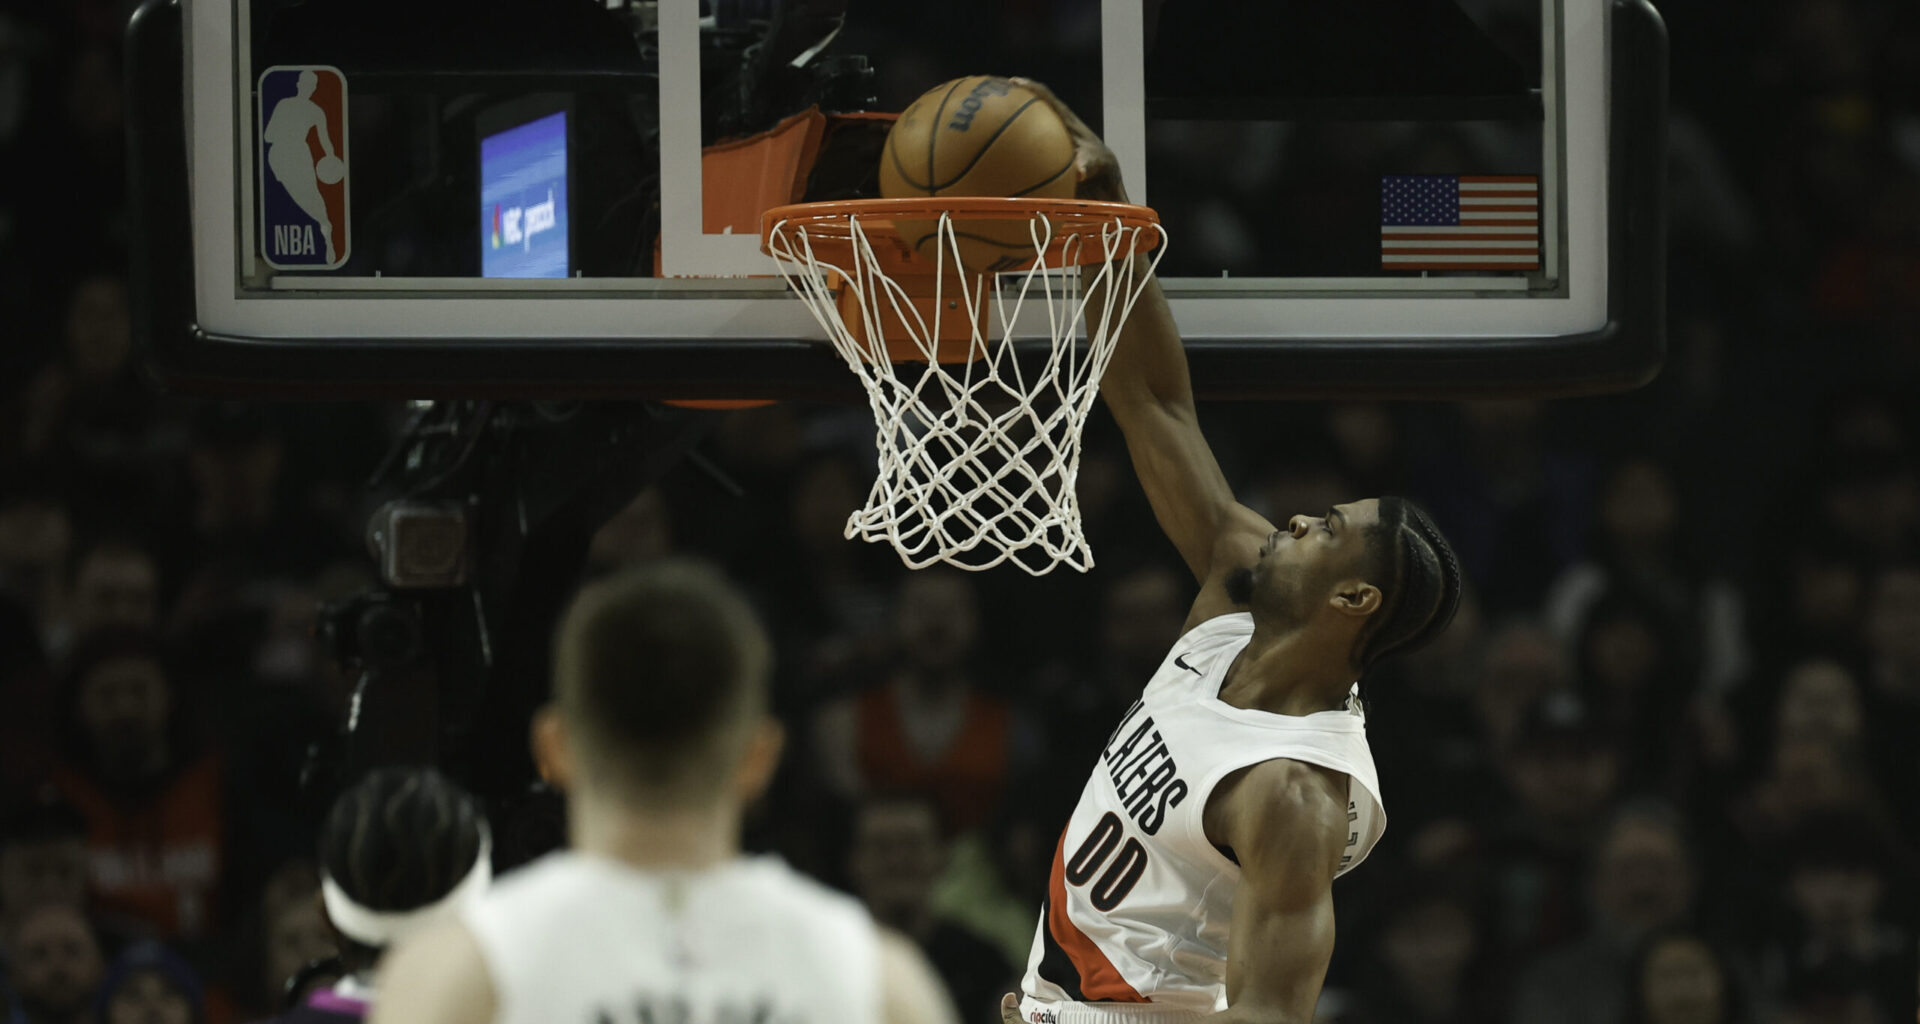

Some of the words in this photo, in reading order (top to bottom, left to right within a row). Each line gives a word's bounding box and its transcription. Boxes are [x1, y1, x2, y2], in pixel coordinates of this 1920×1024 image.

[274, 224, 316, 256] NBA
[1103, 700, 1188, 836] LAZERS
[1065, 811, 1148, 913] 00
